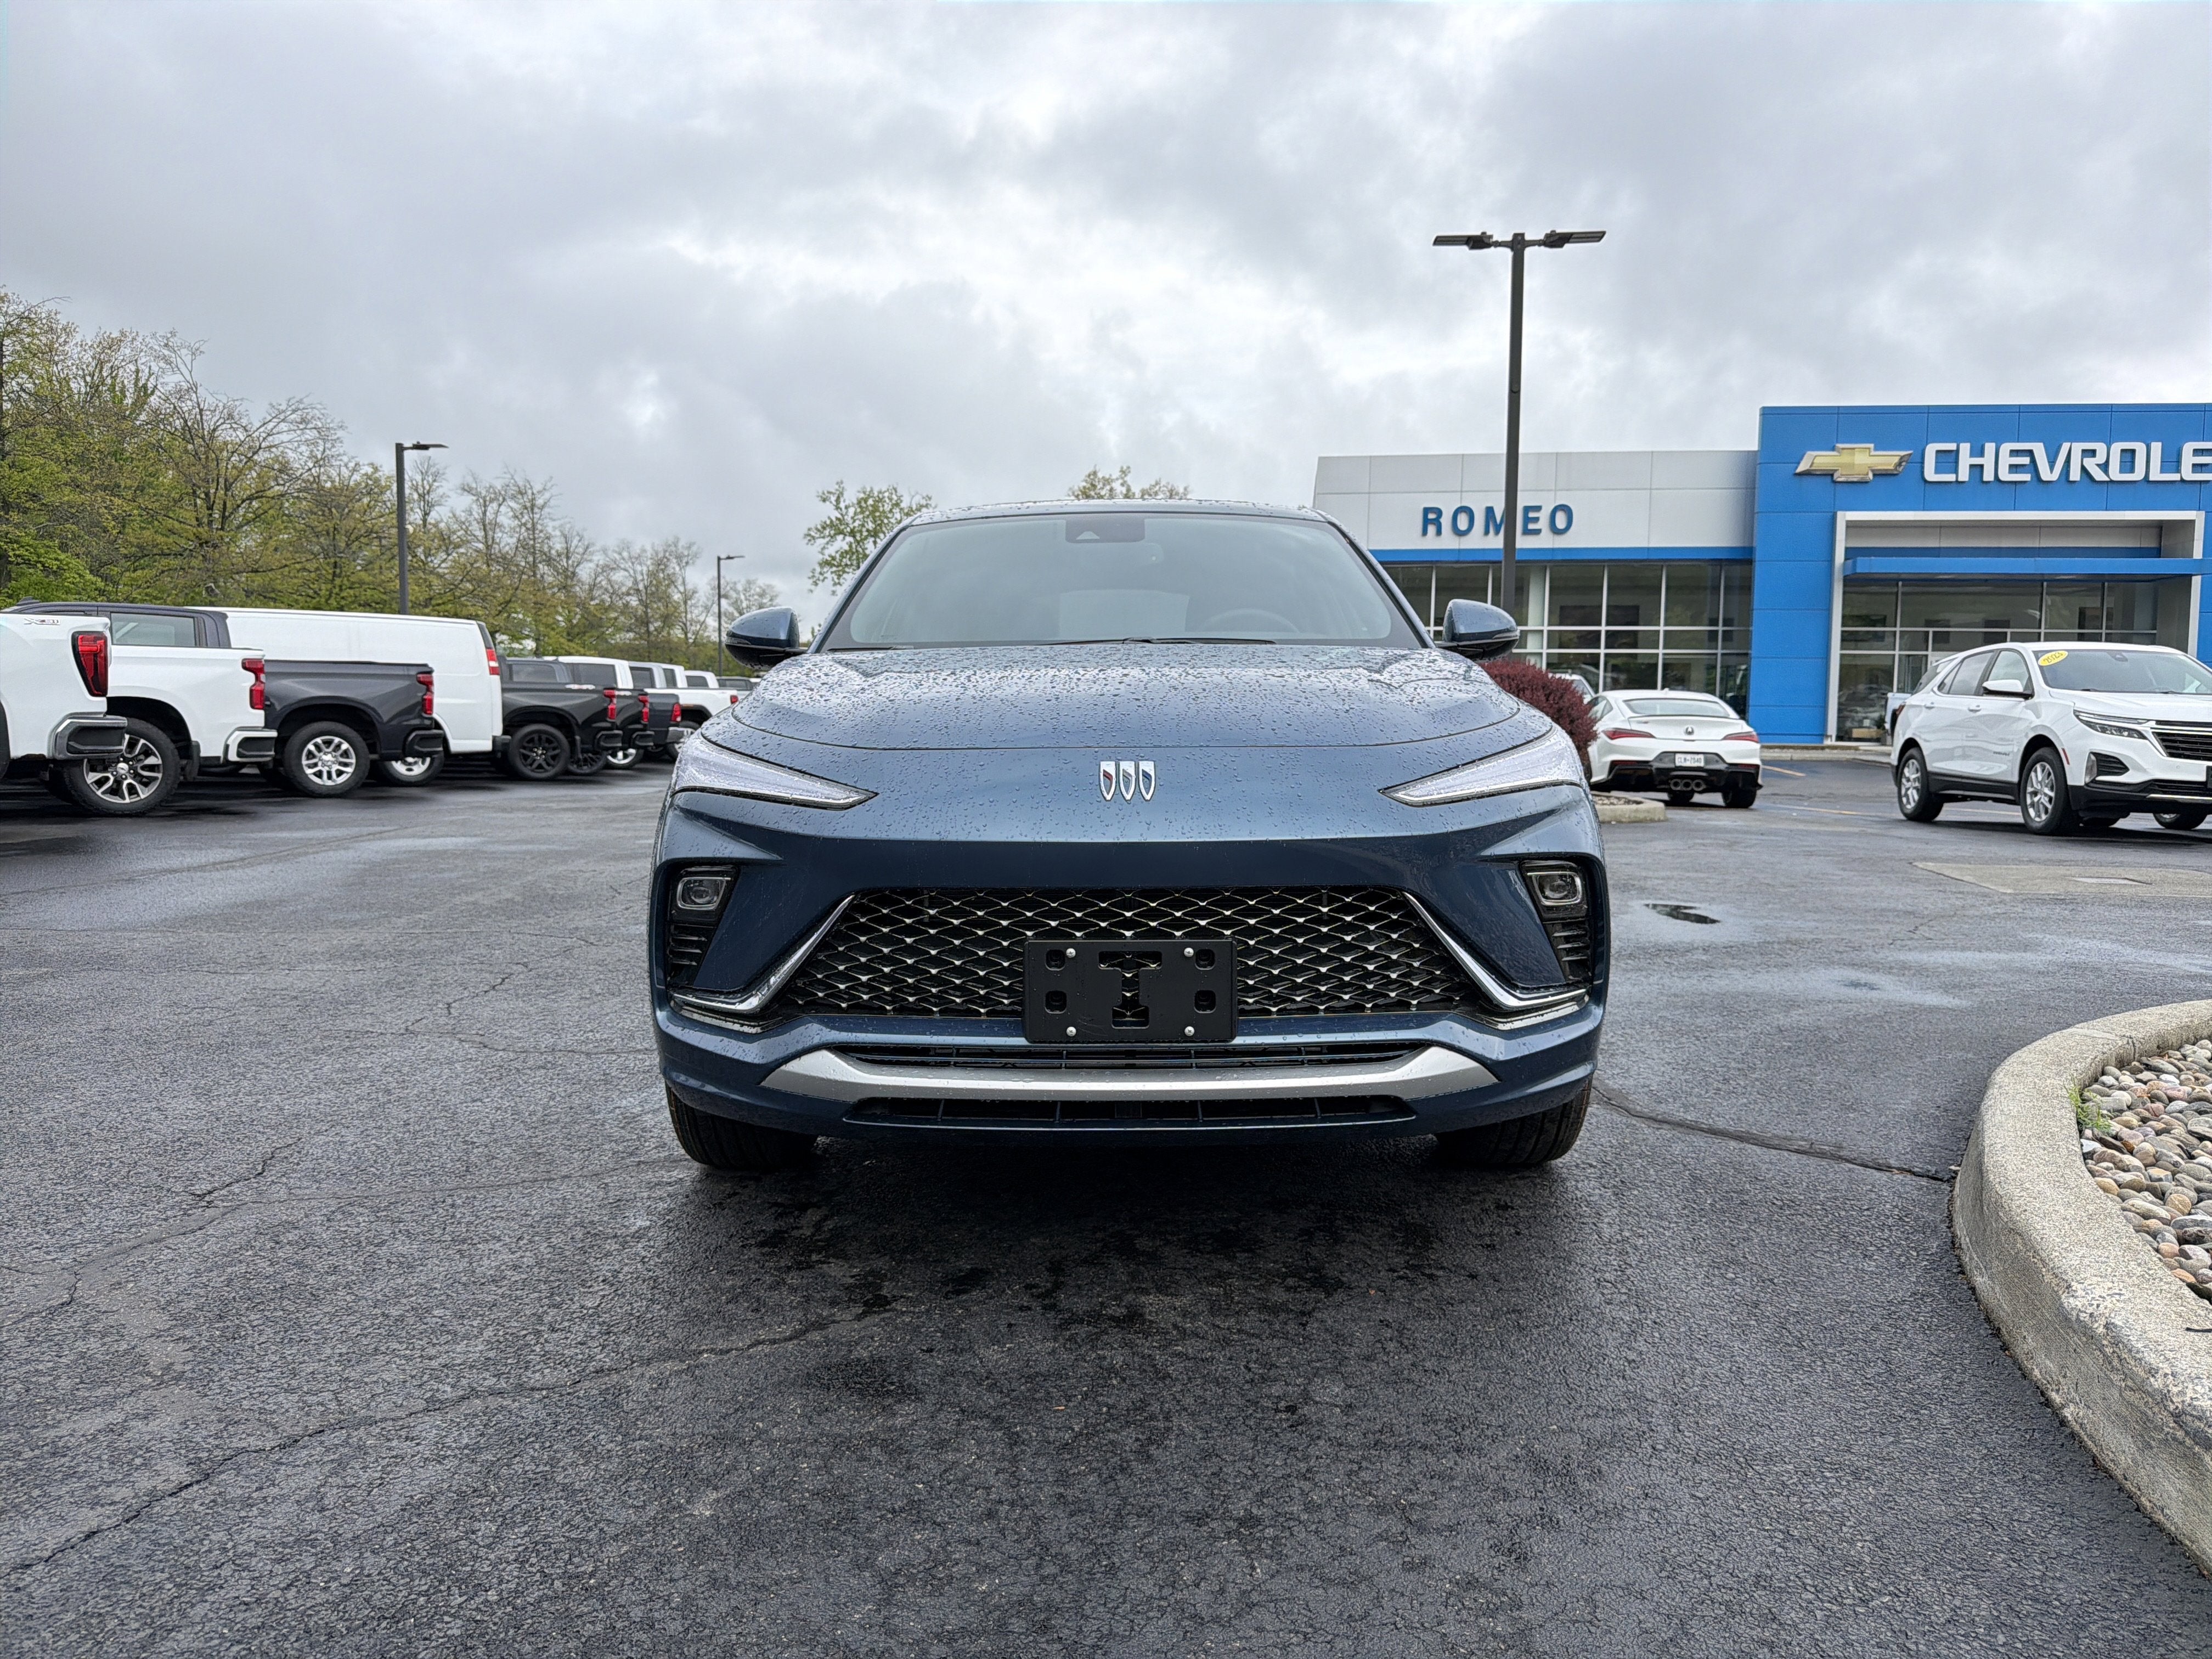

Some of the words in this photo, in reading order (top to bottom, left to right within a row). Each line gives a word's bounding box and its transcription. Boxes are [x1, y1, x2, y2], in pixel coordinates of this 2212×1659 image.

[1924, 442, 2212, 481] CHEVROLE
[1421, 504, 1573, 537] ROMEO
[2043, 652, 2063, 663] 2023
